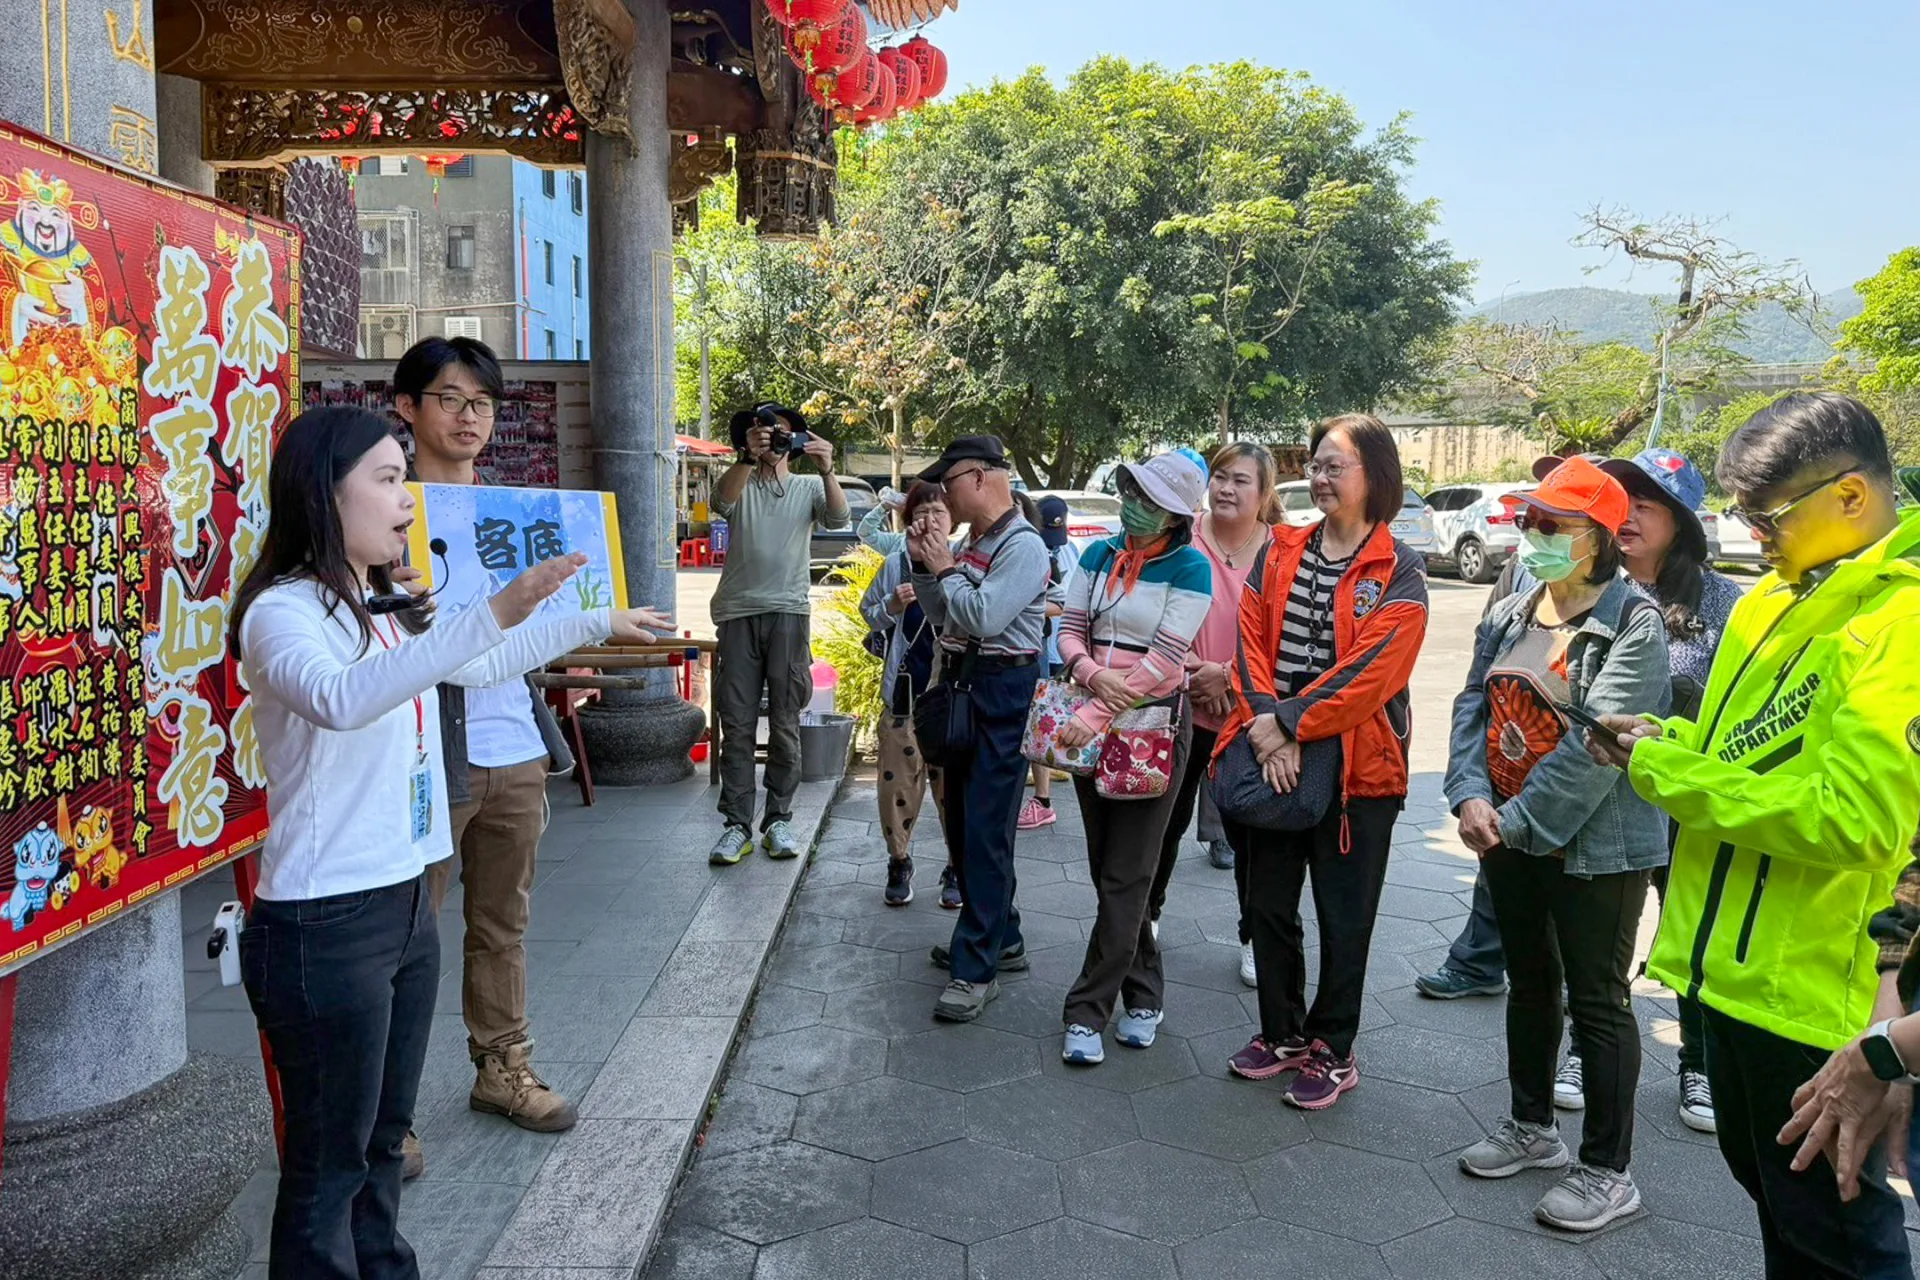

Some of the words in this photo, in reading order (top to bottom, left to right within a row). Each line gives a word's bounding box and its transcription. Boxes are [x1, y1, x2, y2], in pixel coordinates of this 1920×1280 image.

[42, 422, 68, 633] 副主任委員
[69, 424, 94, 629] 副主任委員
[96, 428, 118, 625] 主任委員
[146, 249, 225, 844] 萬事如意
[224, 243, 287, 788] 恭賀
[473, 516, 565, 569] 客底
